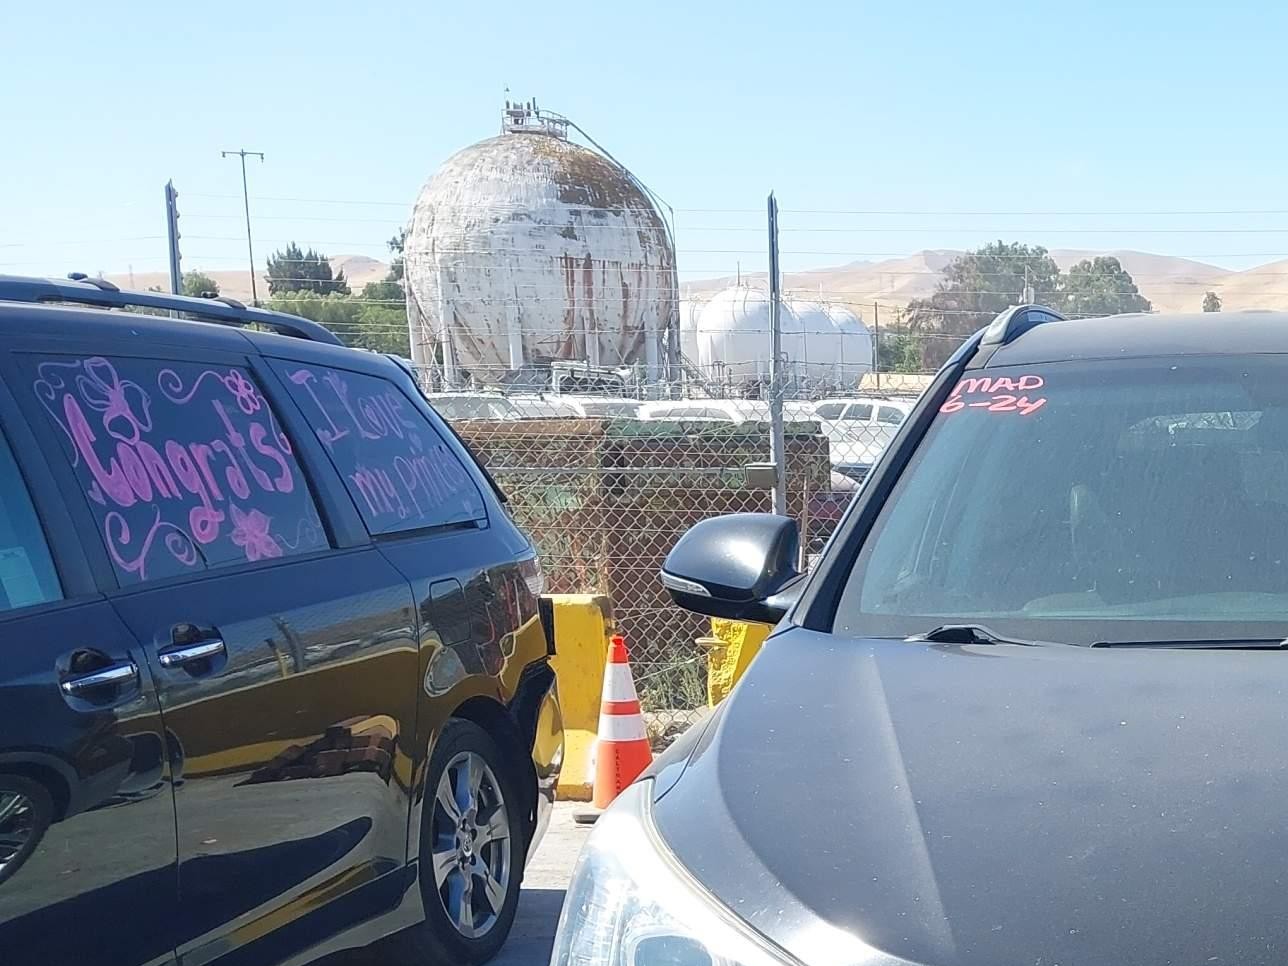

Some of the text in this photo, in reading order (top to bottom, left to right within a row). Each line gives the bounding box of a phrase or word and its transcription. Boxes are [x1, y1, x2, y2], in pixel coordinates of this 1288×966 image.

[284, 369, 319, 441] I
[940, 395, 1046, 415] 6-24
[951, 375, 1043, 397] MAD
[63, 393, 294, 544] Congrats
[349, 465, 408, 519] my
